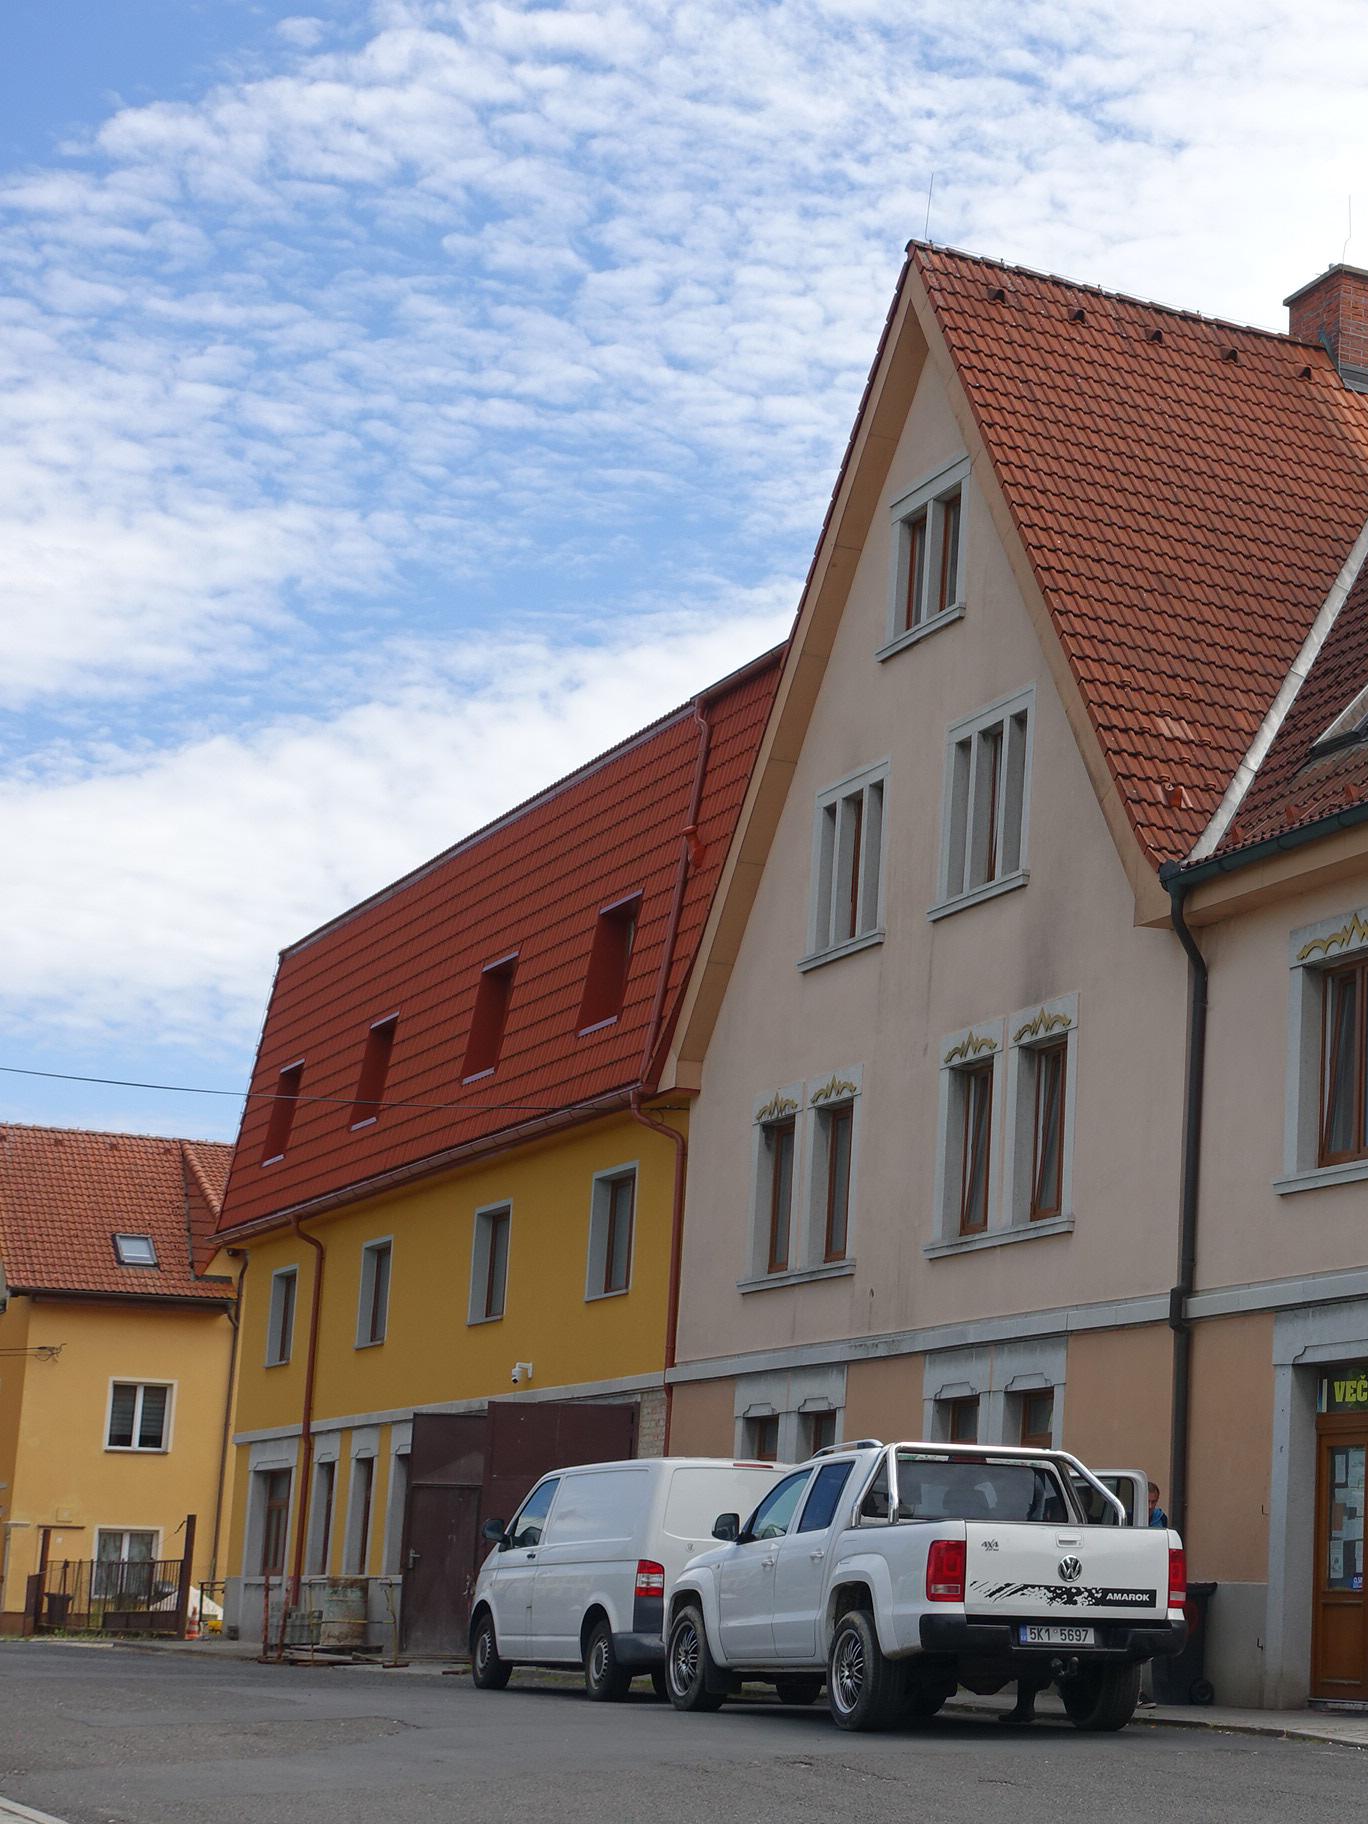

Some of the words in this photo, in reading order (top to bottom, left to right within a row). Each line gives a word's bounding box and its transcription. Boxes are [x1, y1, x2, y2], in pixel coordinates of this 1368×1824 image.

[1106, 1592, 1150, 1602] AMAROK
[1029, 1627, 1051, 1641] 5K1
[1060, 1628, 1089, 1643] 5697
